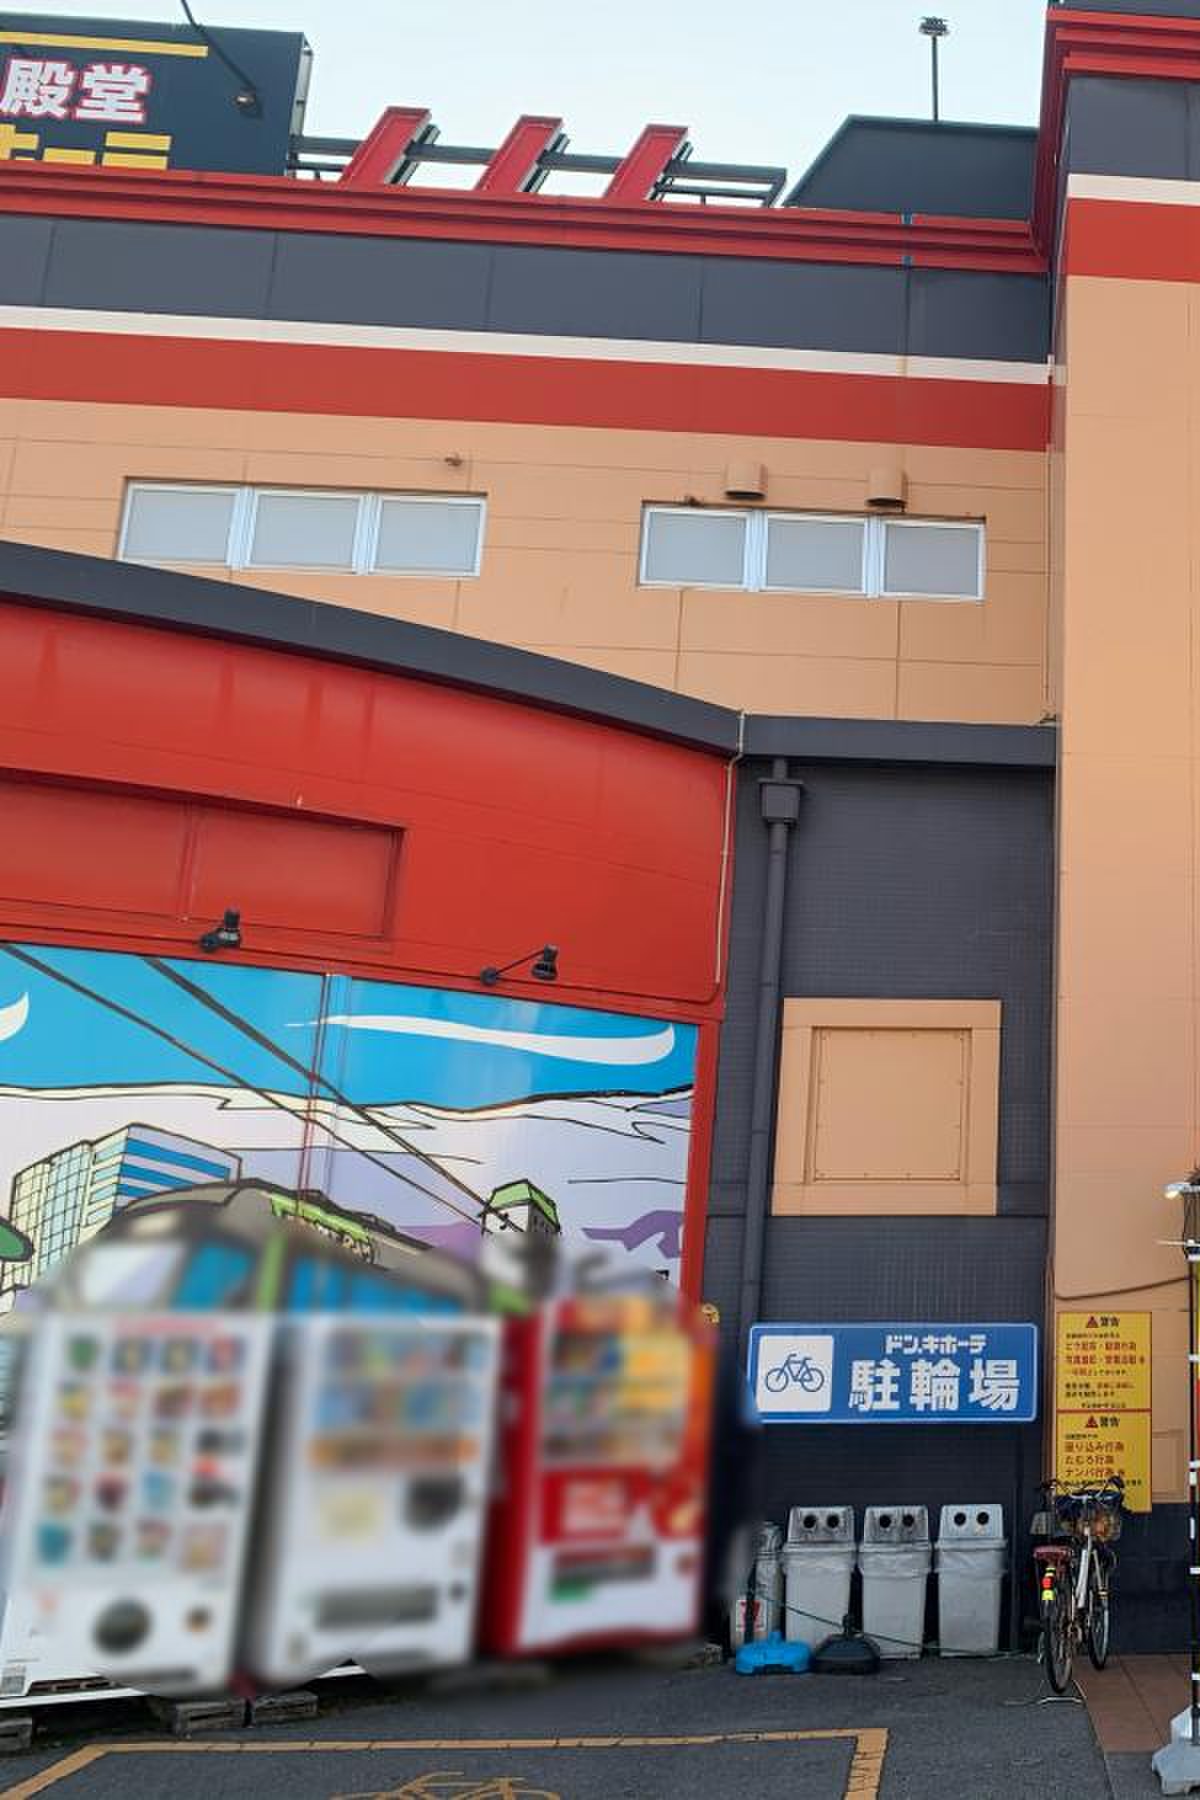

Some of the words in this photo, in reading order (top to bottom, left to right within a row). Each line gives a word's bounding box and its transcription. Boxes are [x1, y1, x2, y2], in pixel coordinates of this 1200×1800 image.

[1, 58, 150, 124] 殿堂
[848, 1359, 1021, 1412] 駐輪場
